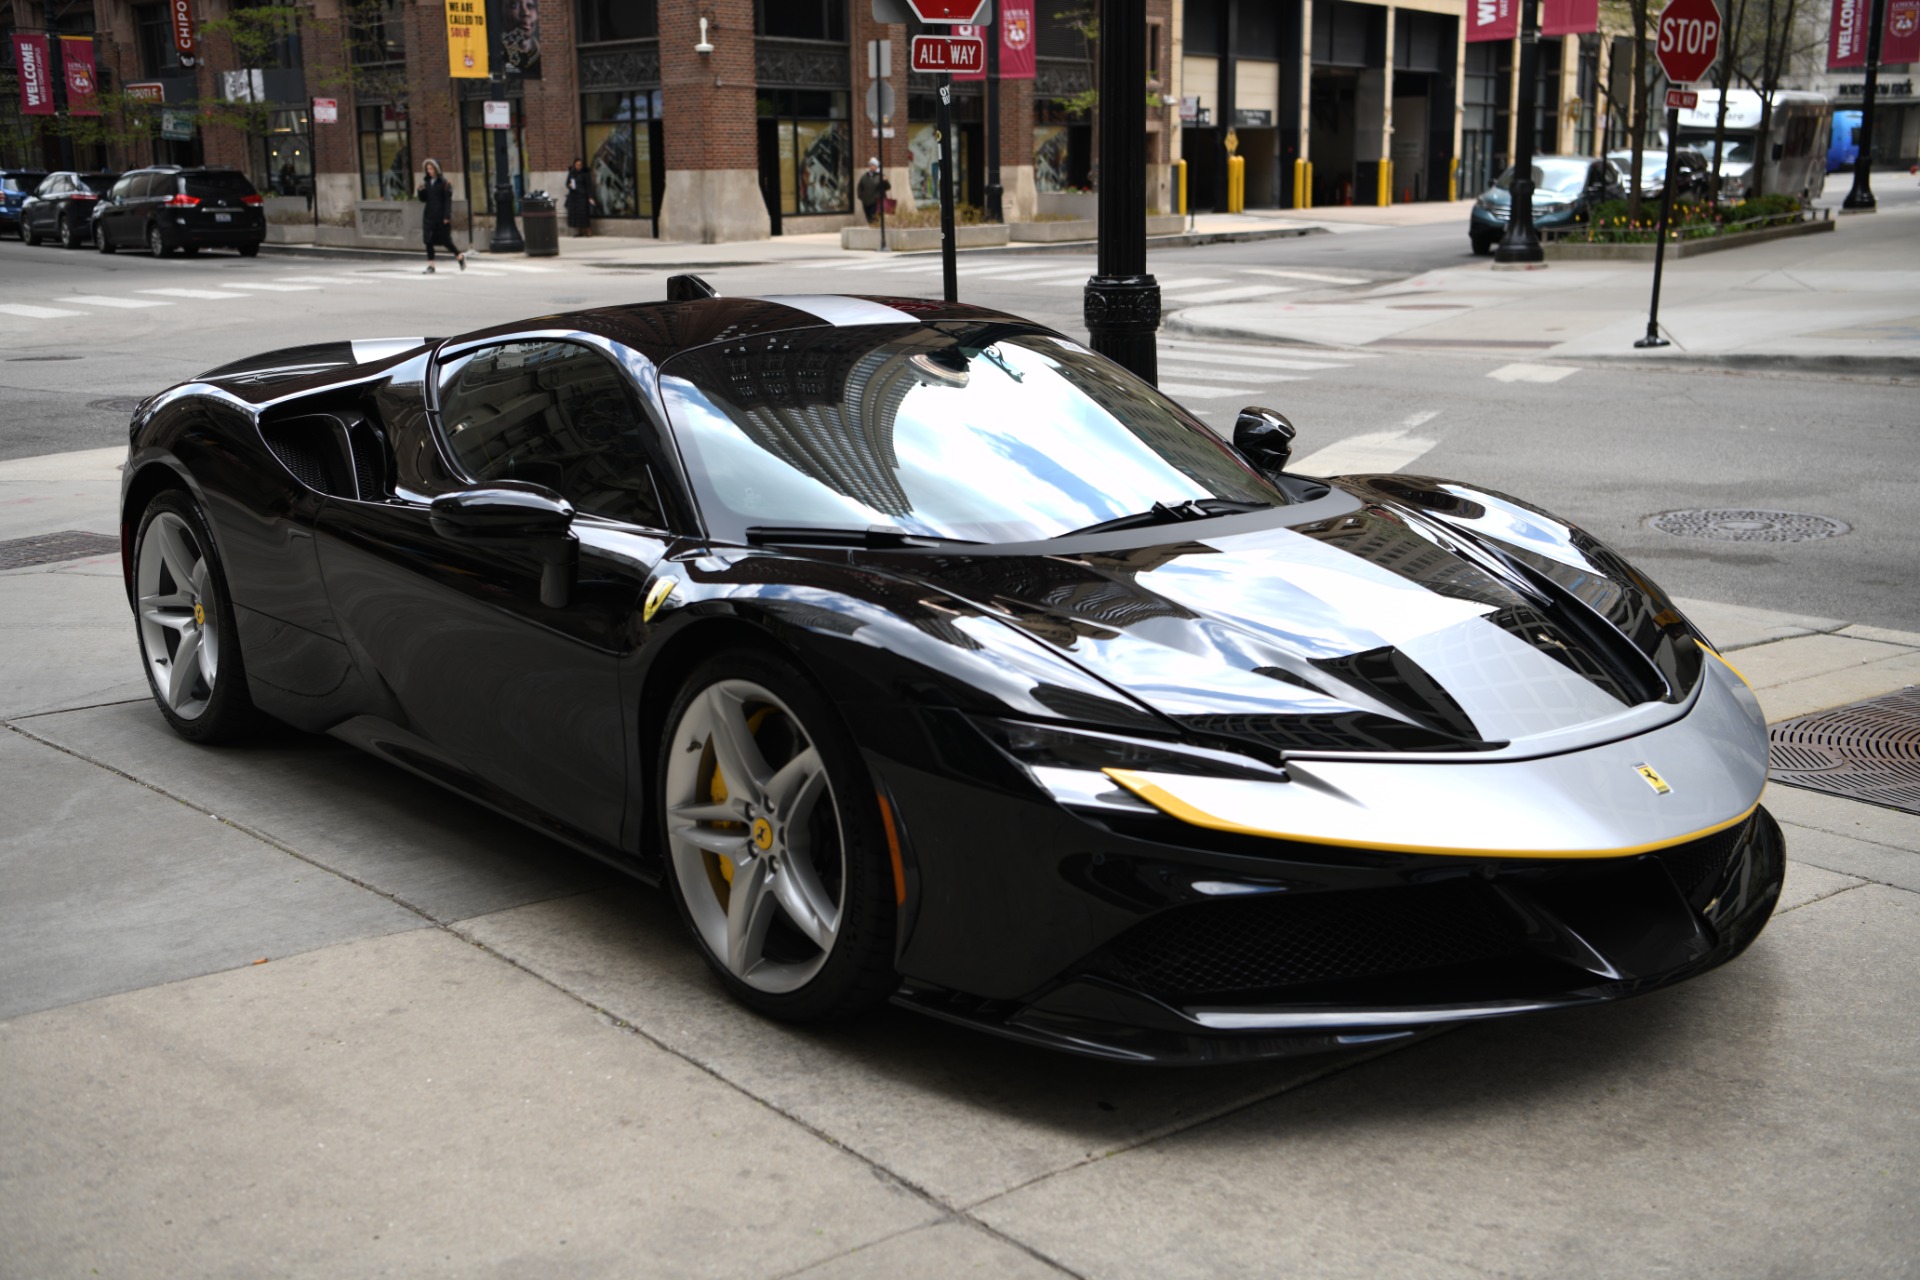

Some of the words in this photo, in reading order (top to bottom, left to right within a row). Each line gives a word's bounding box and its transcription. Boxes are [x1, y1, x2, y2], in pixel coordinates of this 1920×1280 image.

[449, 2, 459, 12] WE
[461, 2, 474, 13] ARE
[450, 14, 473, 26] CALLED
[475, 15, 484, 26] TO
[1661, 17, 1717, 55] STOP
[920, 44, 945, 64] ALL
[951, 45, 976, 65] WAY
[20, 43, 40, 106] WELCOME
